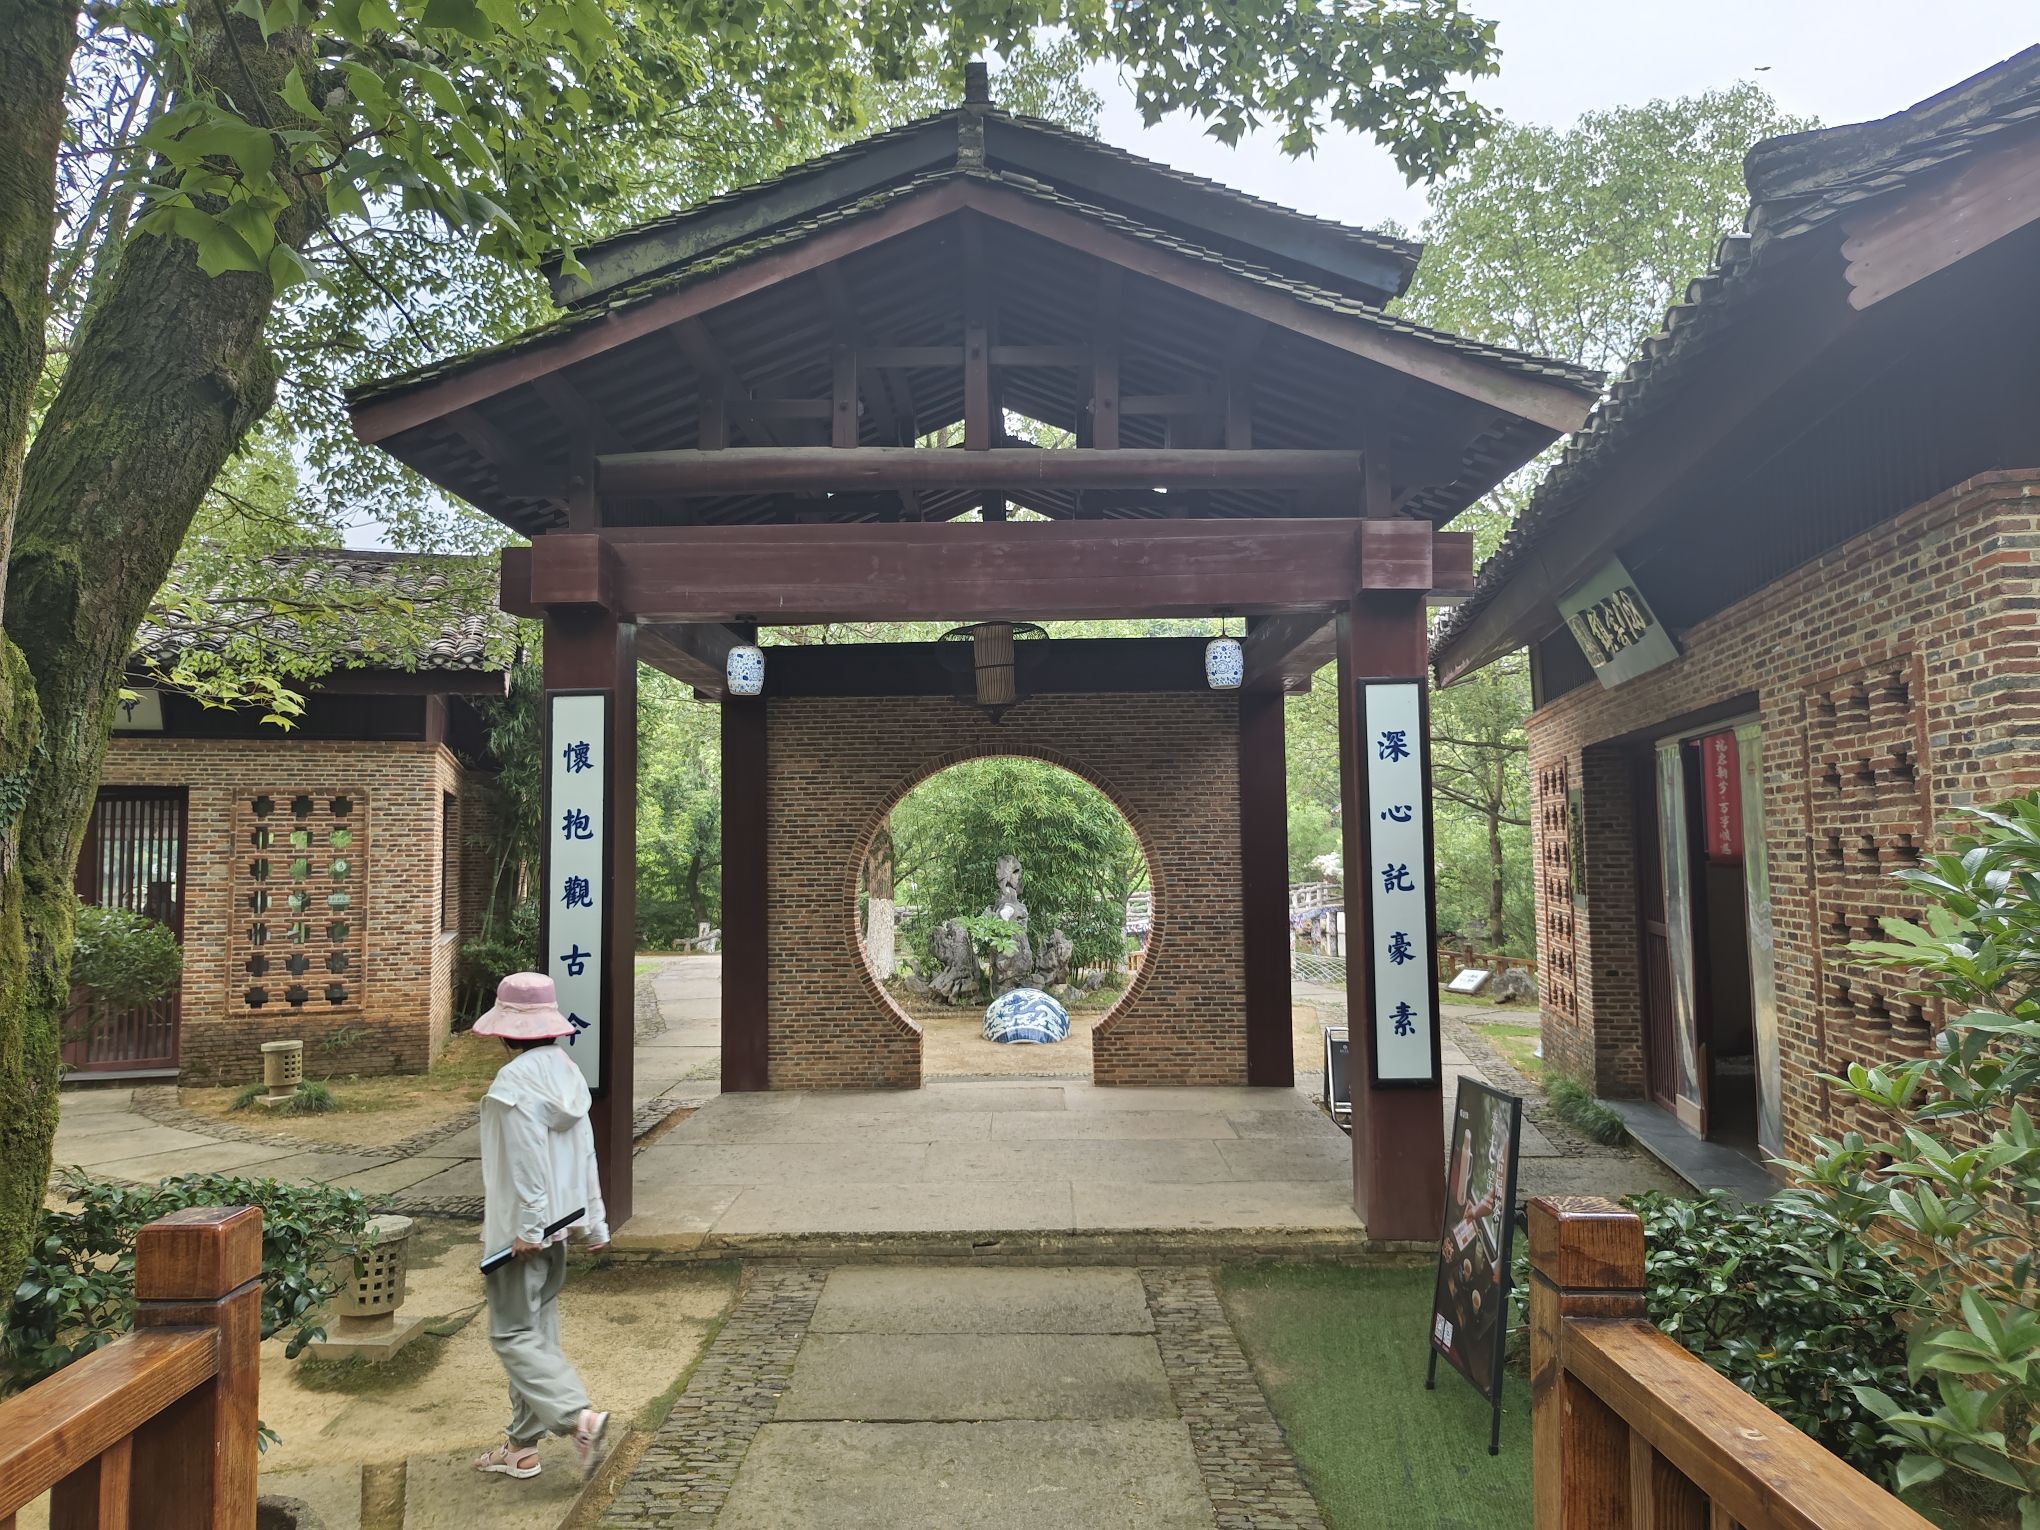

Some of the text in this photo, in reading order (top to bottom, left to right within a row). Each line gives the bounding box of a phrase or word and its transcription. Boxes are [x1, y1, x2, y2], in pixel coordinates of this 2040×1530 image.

[560, 740, 593, 1047] 懷抱觀古今
[1377, 730, 1417, 1037] 深心託豪素
